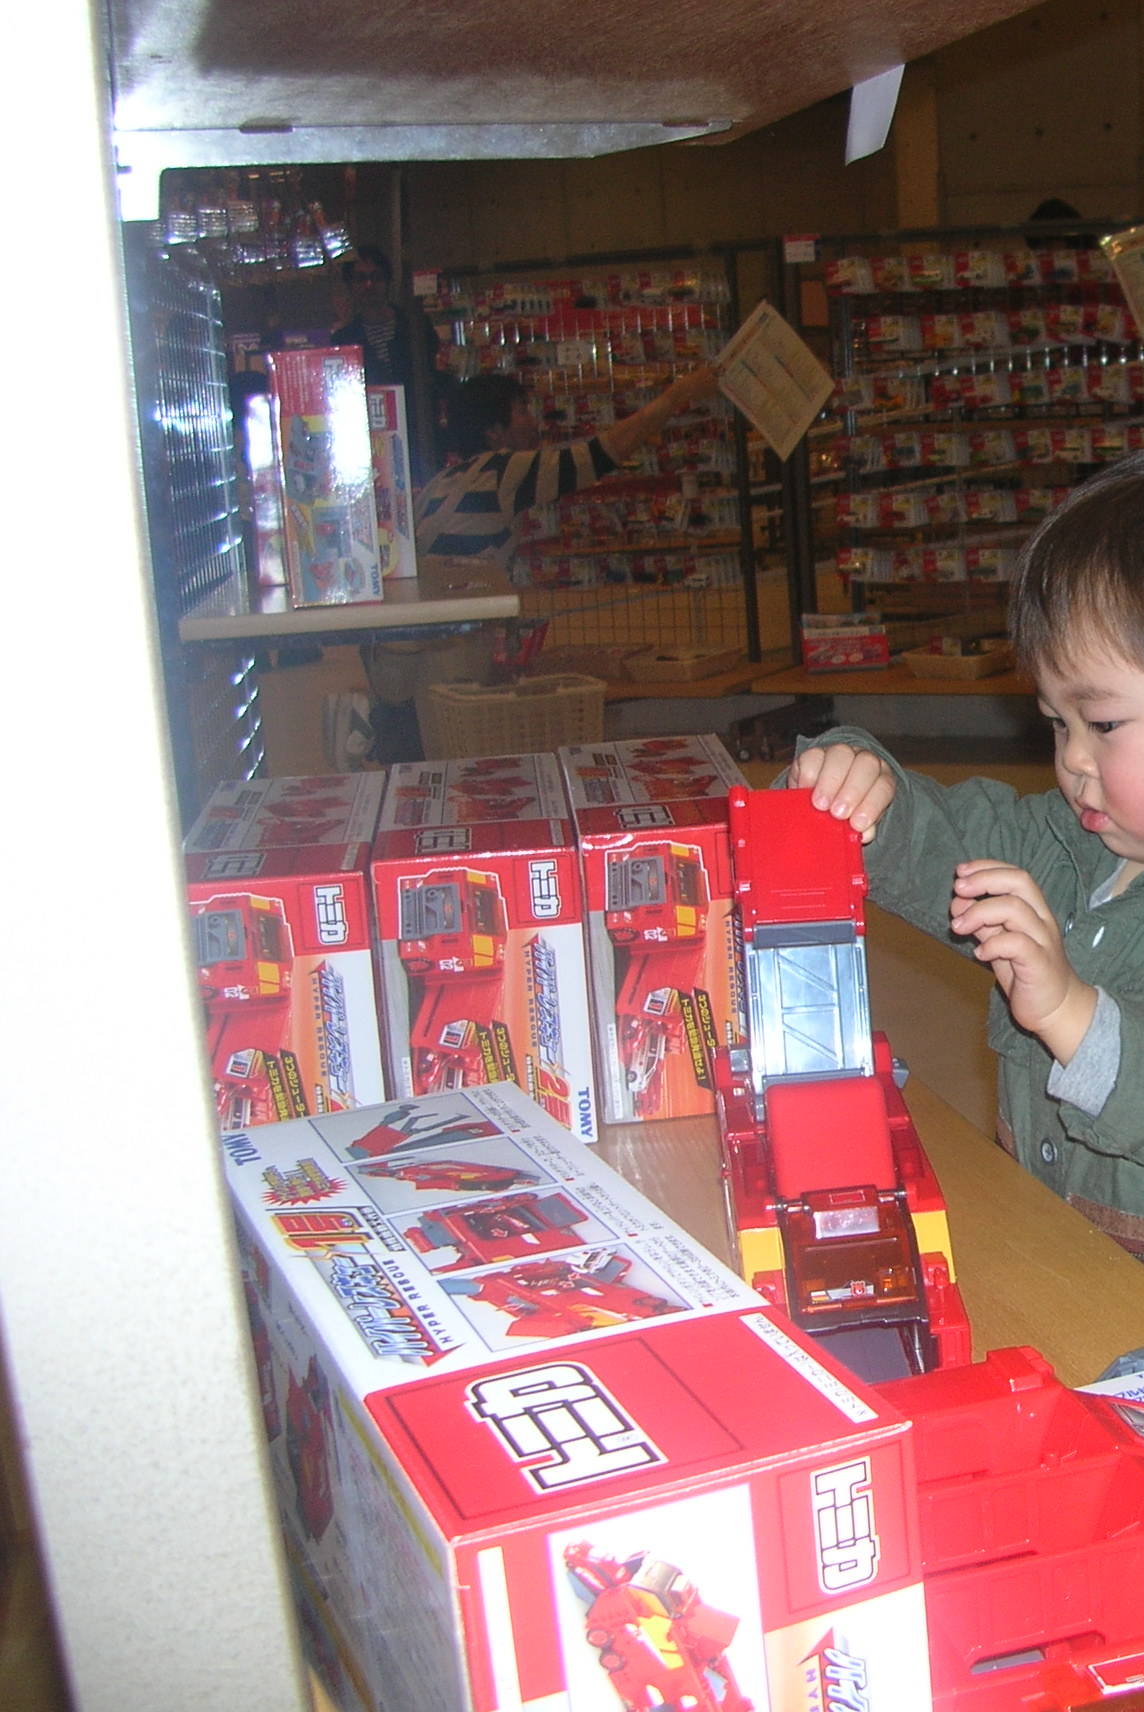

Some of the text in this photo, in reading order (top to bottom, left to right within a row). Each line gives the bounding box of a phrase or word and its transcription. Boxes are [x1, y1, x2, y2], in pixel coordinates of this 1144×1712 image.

[370, 565, 380, 596] TOMY
[528, 859, 562, 919] トミカ
[313, 884, 349, 945] トミカ
[524, 951, 533, 992] HYPER
[312, 977, 322, 1020] HYPER
[577, 1087, 594, 1138] TOMY
[220, 1133, 262, 1166] TOMY
[382, 1258, 421, 1301] RESCUE
[331, 1255, 434, 1357] ハイパーレスキュー
[416, 1303, 454, 1344] HYPER
[464, 1360, 669, 1494] トミカ
[809, 1456, 881, 1595] トミカ
